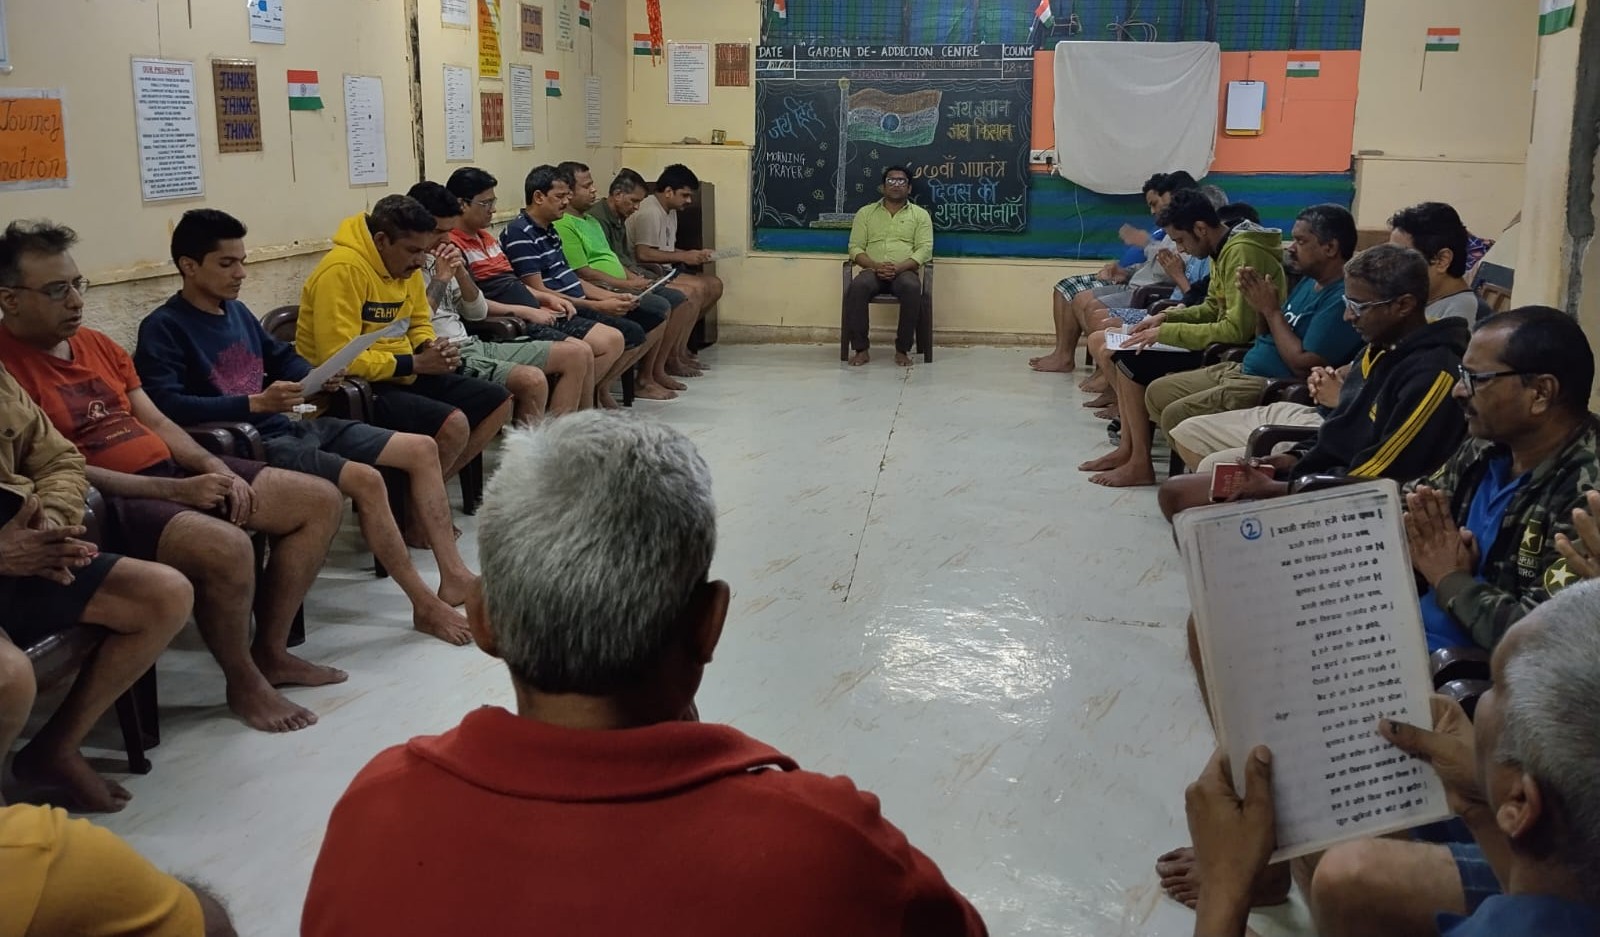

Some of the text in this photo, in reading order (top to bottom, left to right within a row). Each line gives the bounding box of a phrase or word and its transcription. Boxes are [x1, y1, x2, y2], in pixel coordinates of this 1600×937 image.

[759, 46, 783, 58] DATE
[807, 46, 850, 57] GARDEN
[942, 45, 980, 57] CENTRE
[1003, 44, 1034, 56] COUNT
[220, 71, 251, 89] THINK
[223, 97, 253, 114] THINK
[946, 99, 1012, 118] जय जवान
[225, 122, 255, 140] THINK
[768, 112, 798, 139] जय
[946, 116, 1016, 142] जय किसान
[766, 151, 806, 165] MORNING
[768, 163, 804, 179] PRAYER
[928, 177, 1000, 203] दिवस की
